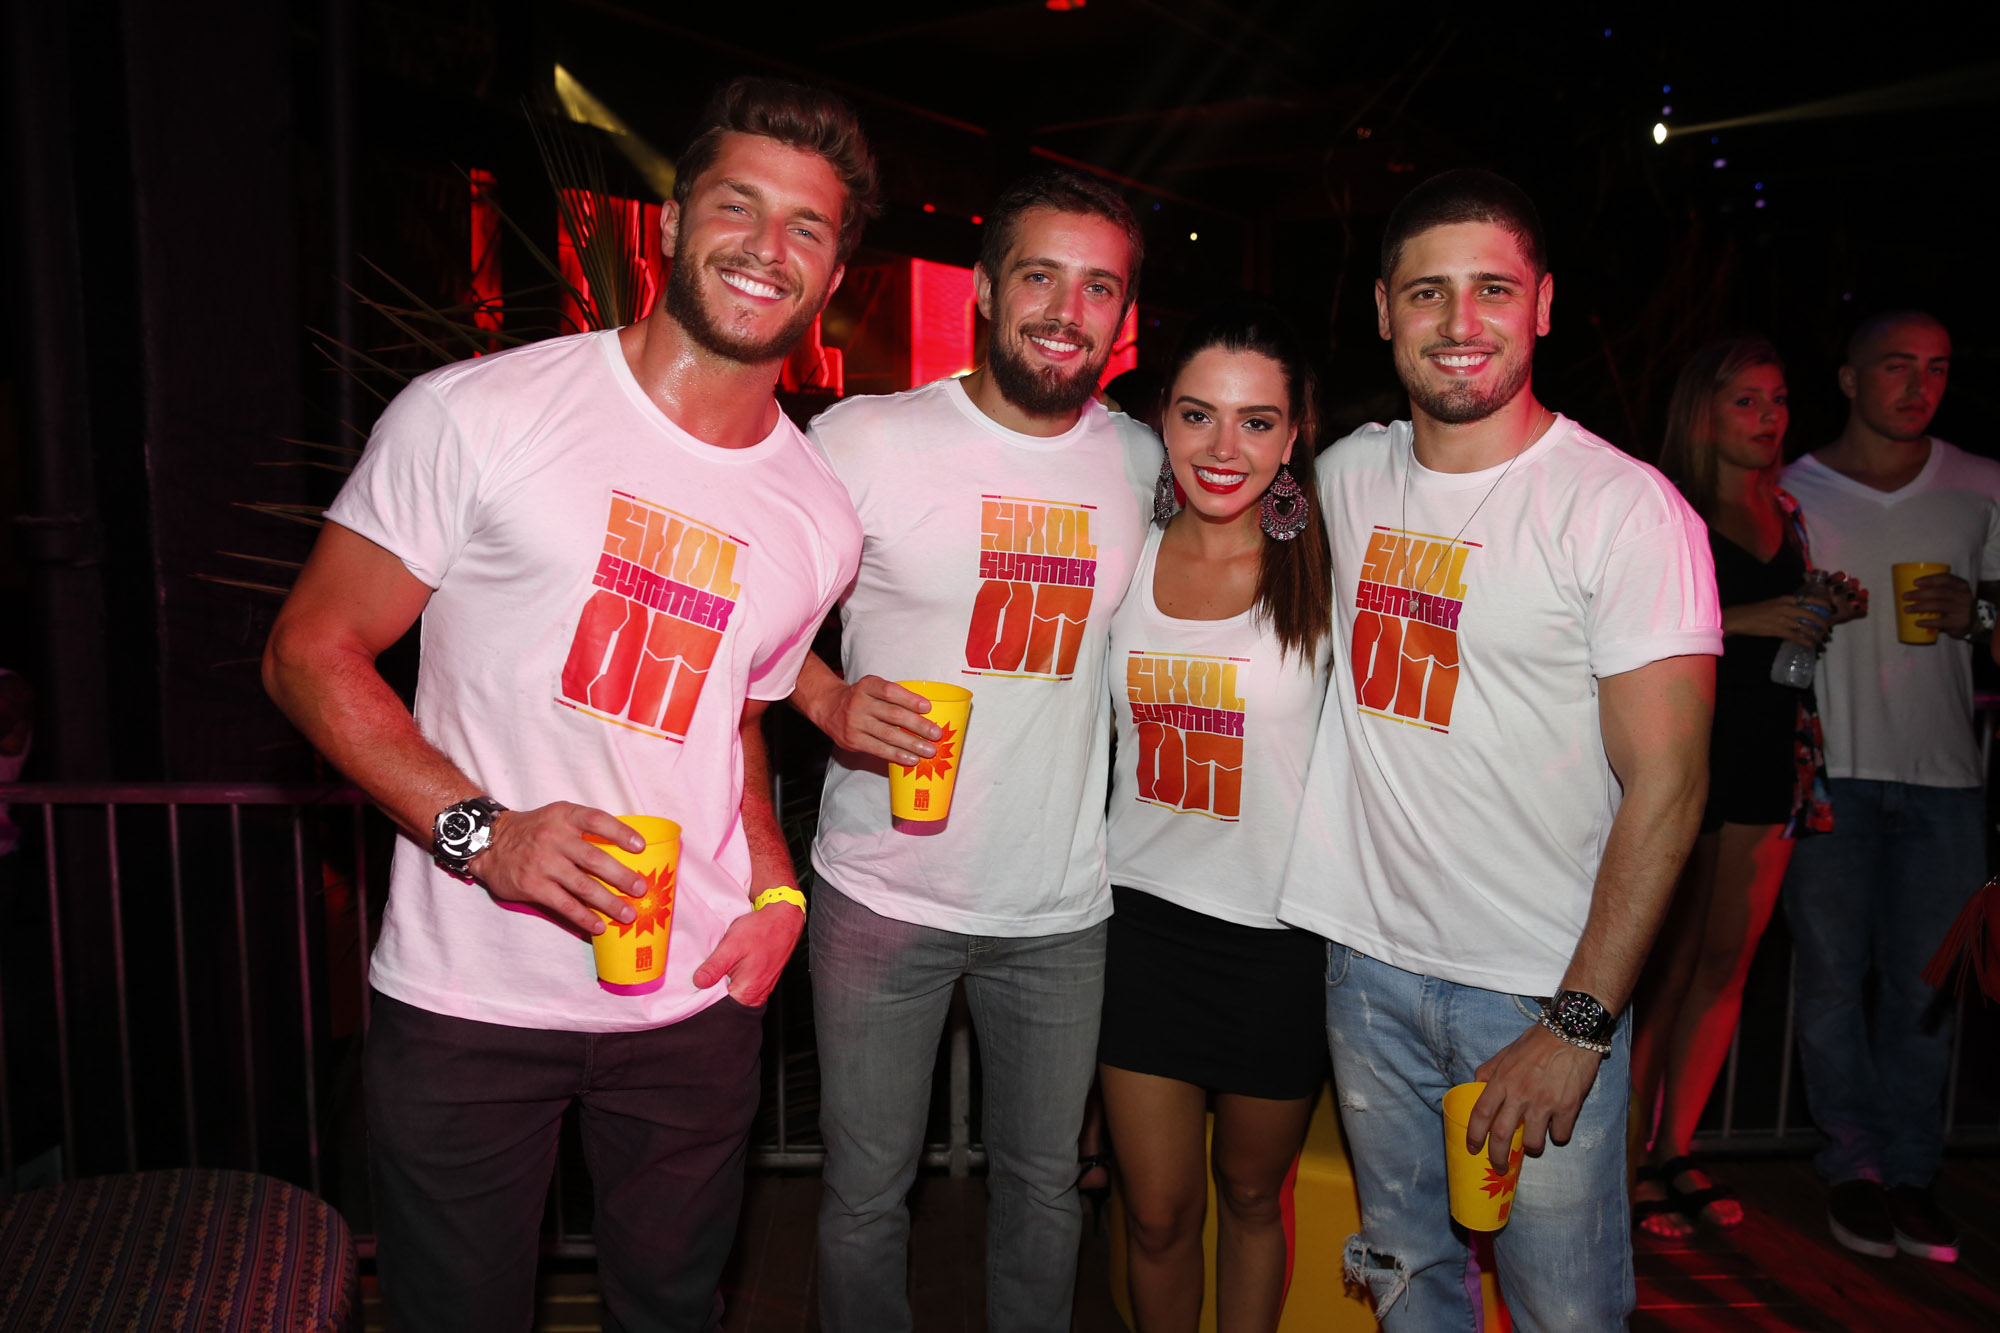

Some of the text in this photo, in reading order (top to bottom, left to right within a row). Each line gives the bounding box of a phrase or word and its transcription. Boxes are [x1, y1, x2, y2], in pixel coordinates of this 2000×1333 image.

[603, 497, 740, 600] SKOL
[981, 501, 1097, 559] SKOL
[592, 552, 735, 632] SUMMER
[979, 551, 1096, 587] SUMMER
[1127, 657, 1245, 711] SKOL
[1129, 702, 1245, 737] SUMMER
